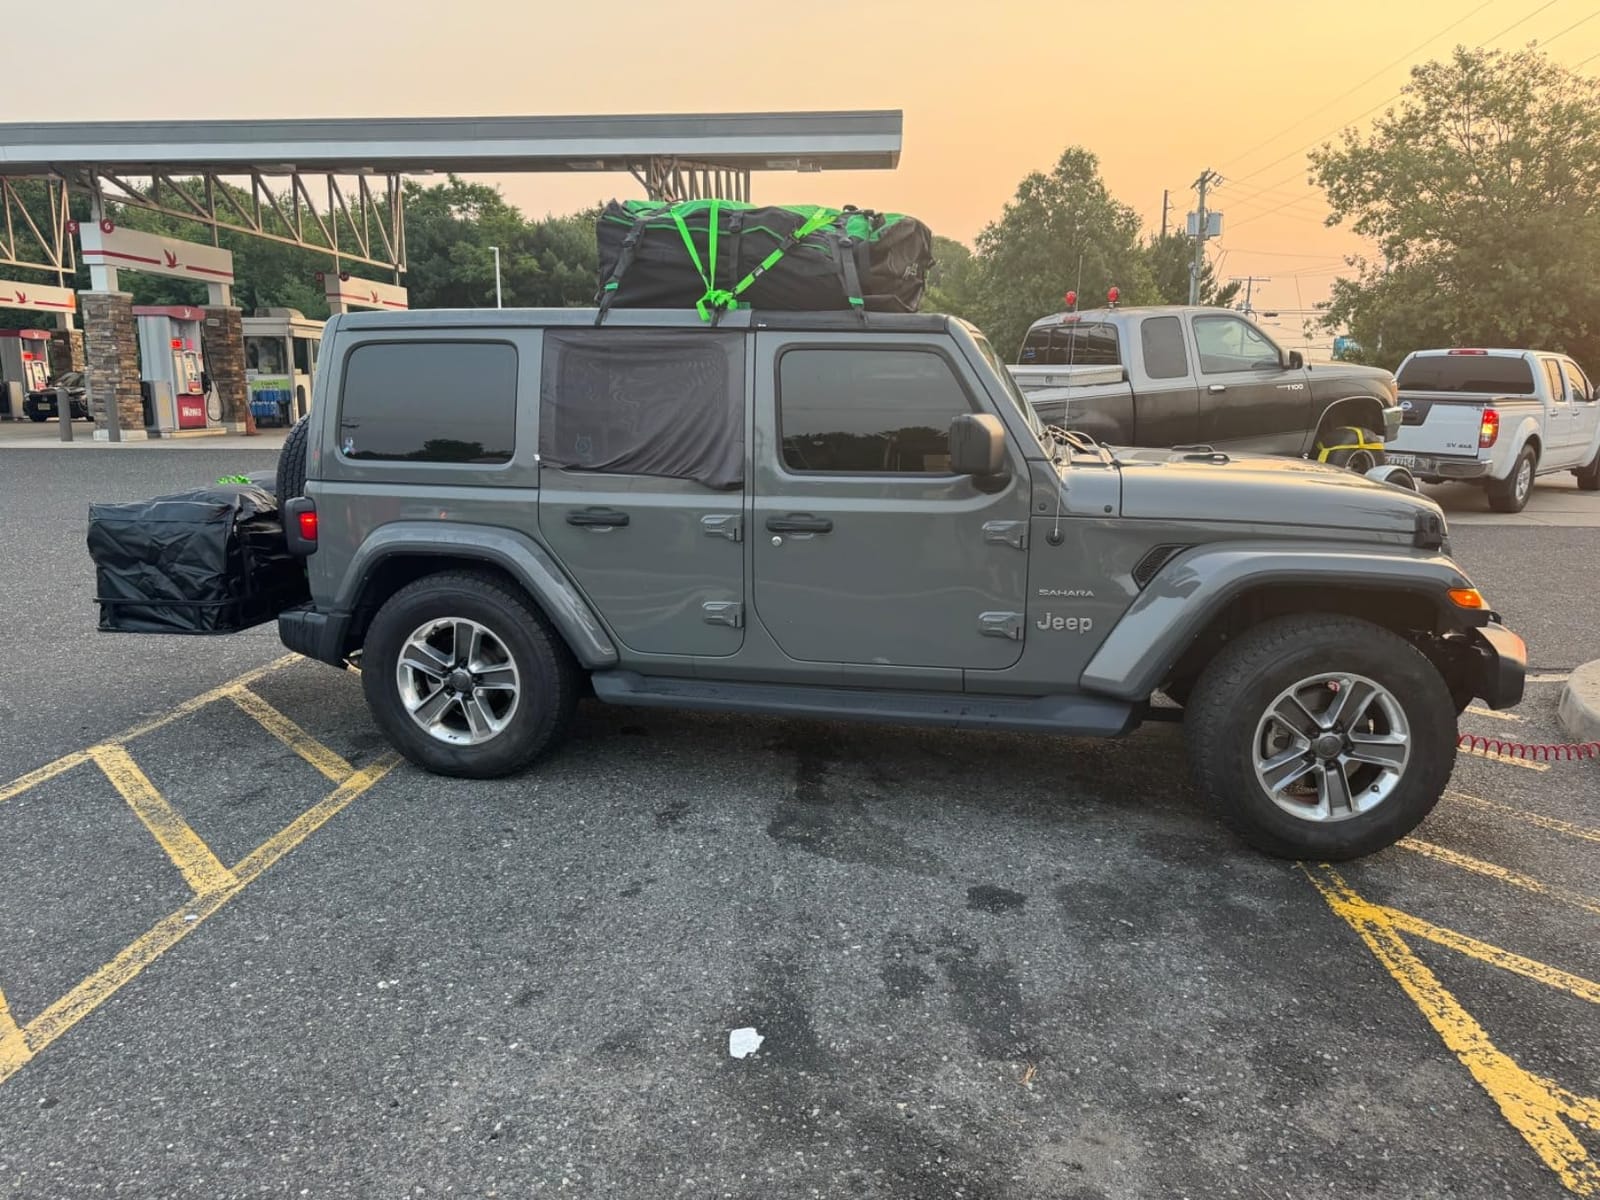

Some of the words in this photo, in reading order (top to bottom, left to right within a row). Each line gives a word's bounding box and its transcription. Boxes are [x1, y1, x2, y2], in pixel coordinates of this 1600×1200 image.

[182, 406, 202, 417] Wawa
[1039, 588, 1095, 597] SAHARA
[1036, 612, 1093, 635] Jeep
